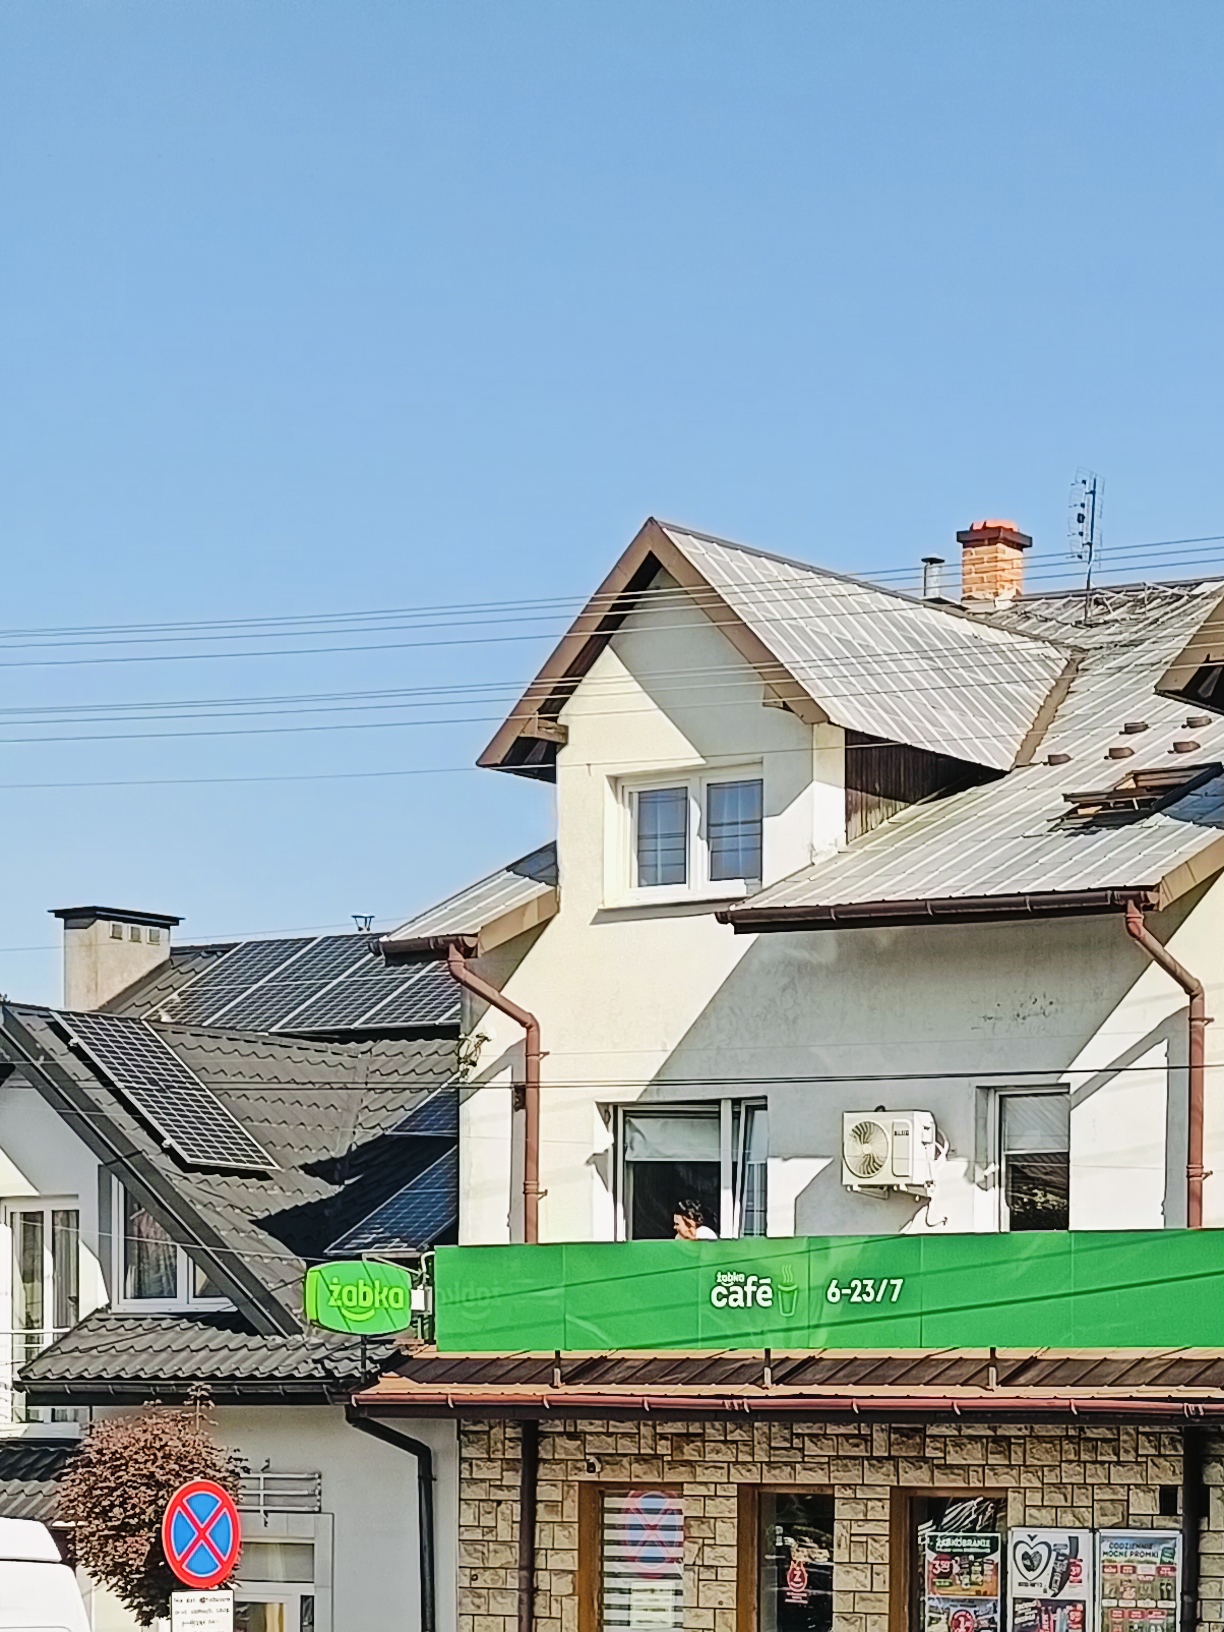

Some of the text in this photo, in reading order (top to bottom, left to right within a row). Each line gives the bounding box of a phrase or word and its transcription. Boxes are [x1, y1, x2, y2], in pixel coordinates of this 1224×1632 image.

[328, 1277, 404, 1309] żabka
[711, 1275, 773, 1308] café
[826, 1279, 904, 1303] 6-23/7
[1103, 1550, 1159, 1558] MOCNE PROMKI
